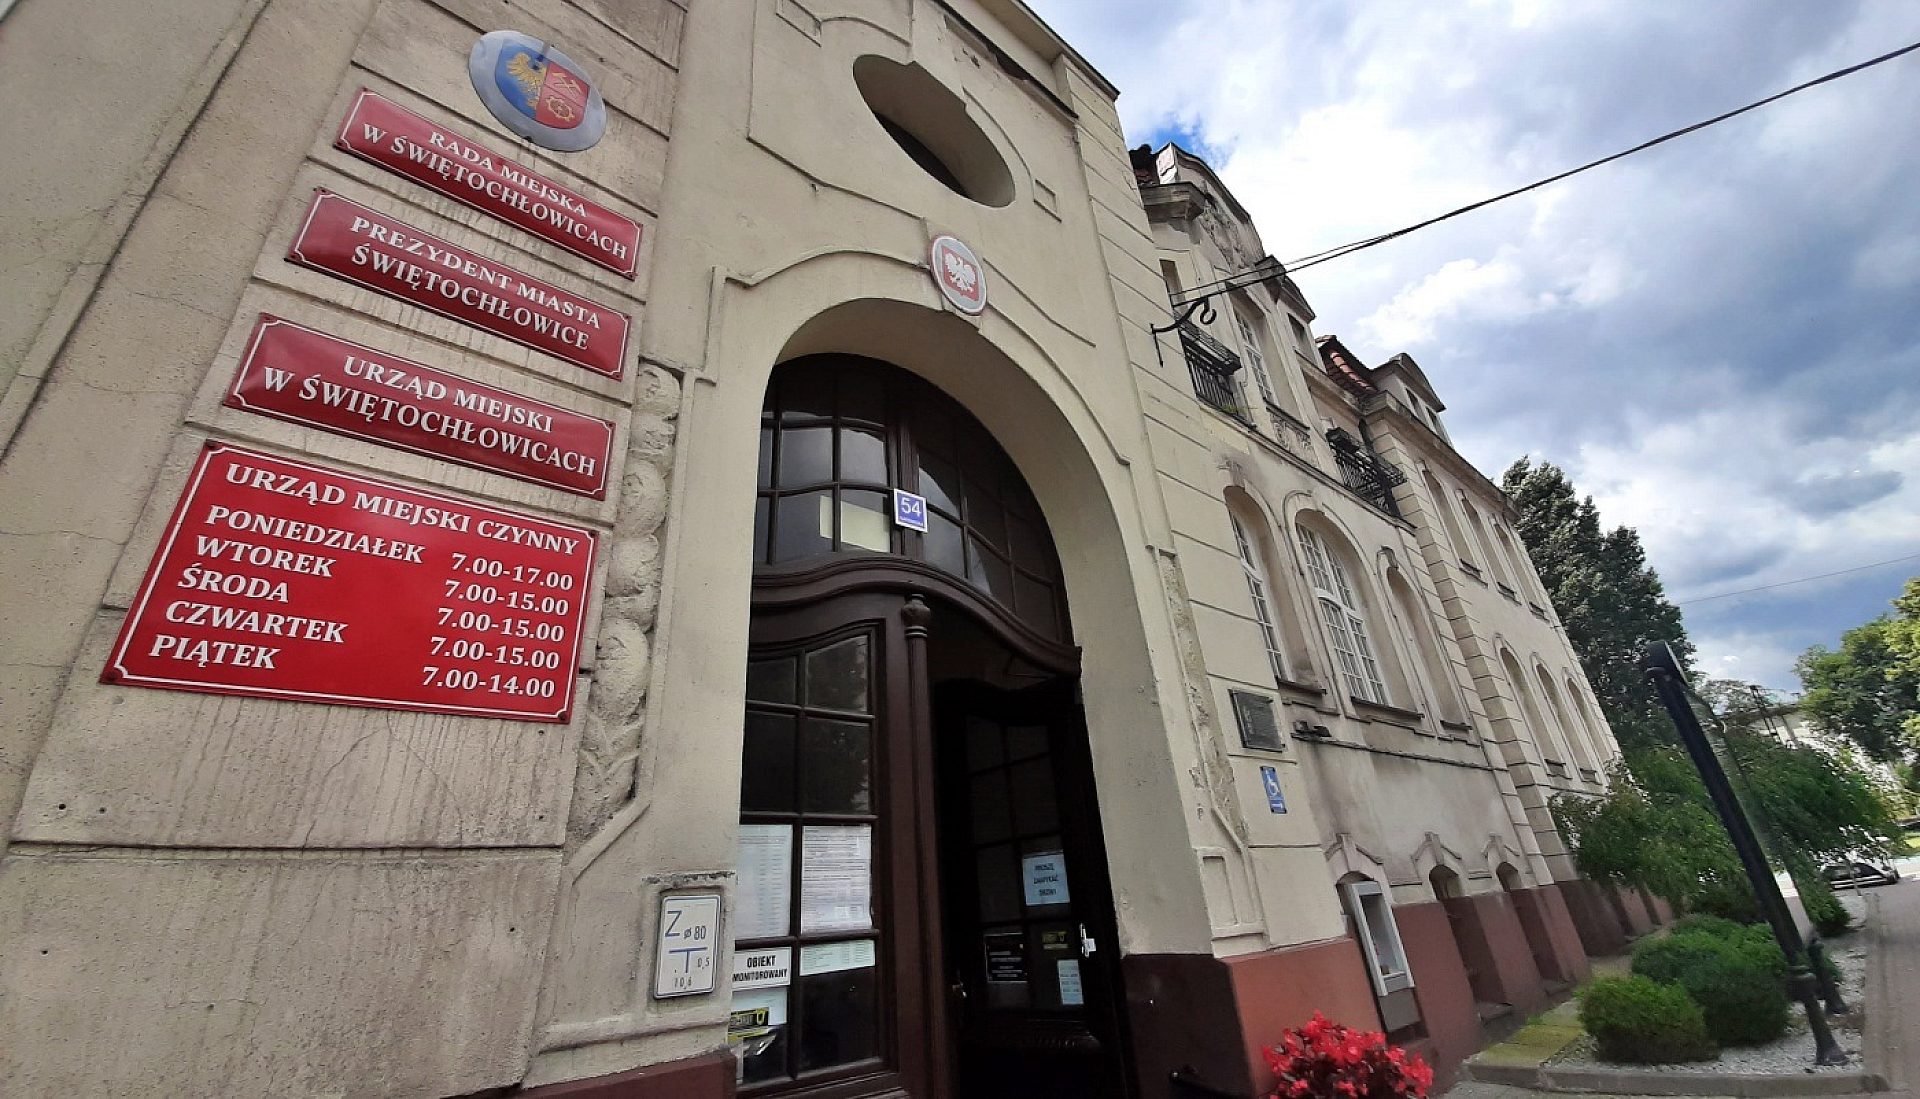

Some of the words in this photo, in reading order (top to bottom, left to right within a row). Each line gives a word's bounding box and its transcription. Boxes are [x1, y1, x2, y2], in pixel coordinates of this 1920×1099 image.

[362, 123, 387, 144] W
[390, 135, 627, 260] ŚWIĘTOCHŁOWICACH
[428, 130, 493, 172] RADA
[499, 164, 587, 218] MIEJSKA
[350, 216, 512, 290] PREZYDENT
[516, 283, 601, 329] MIASTA
[351, 243, 590, 351] ŚWIĘTOCHŁOWICE
[264, 367, 294, 392] W
[299, 373, 596, 477] ŚWIĘTOCHŁOWICACH
[343, 355, 447, 401] URZĄD
[453, 390, 553, 433] MIEJSKI
[205, 504, 426, 565] PONIEDZIAŁEK
[451, 551, 575, 591] 7.00-17.00
[227, 463, 345, 506] URZĄD
[352, 492, 470, 533] MIEJSKI
[476, 519, 579, 556] CZYNNY
[900, 497, 922, 517] 54
[177, 563, 290, 604] ŚRODA
[438, 606, 565, 643] 7.00-15.00
[197, 535, 337, 578] WTOREK
[444, 578, 569, 617] 7.00-15.00
[149, 634, 281, 670] PIĄTEK
[422, 665, 556, 699] 7.00-14.00
[165, 599, 349, 644] CZWARTEK
[430, 635, 560, 670] 7.00-15.00
[665, 910, 682, 937] Z
[746, 954, 776, 969] OBIEKT
[732, 968, 788, 982] MONITOROWANY
